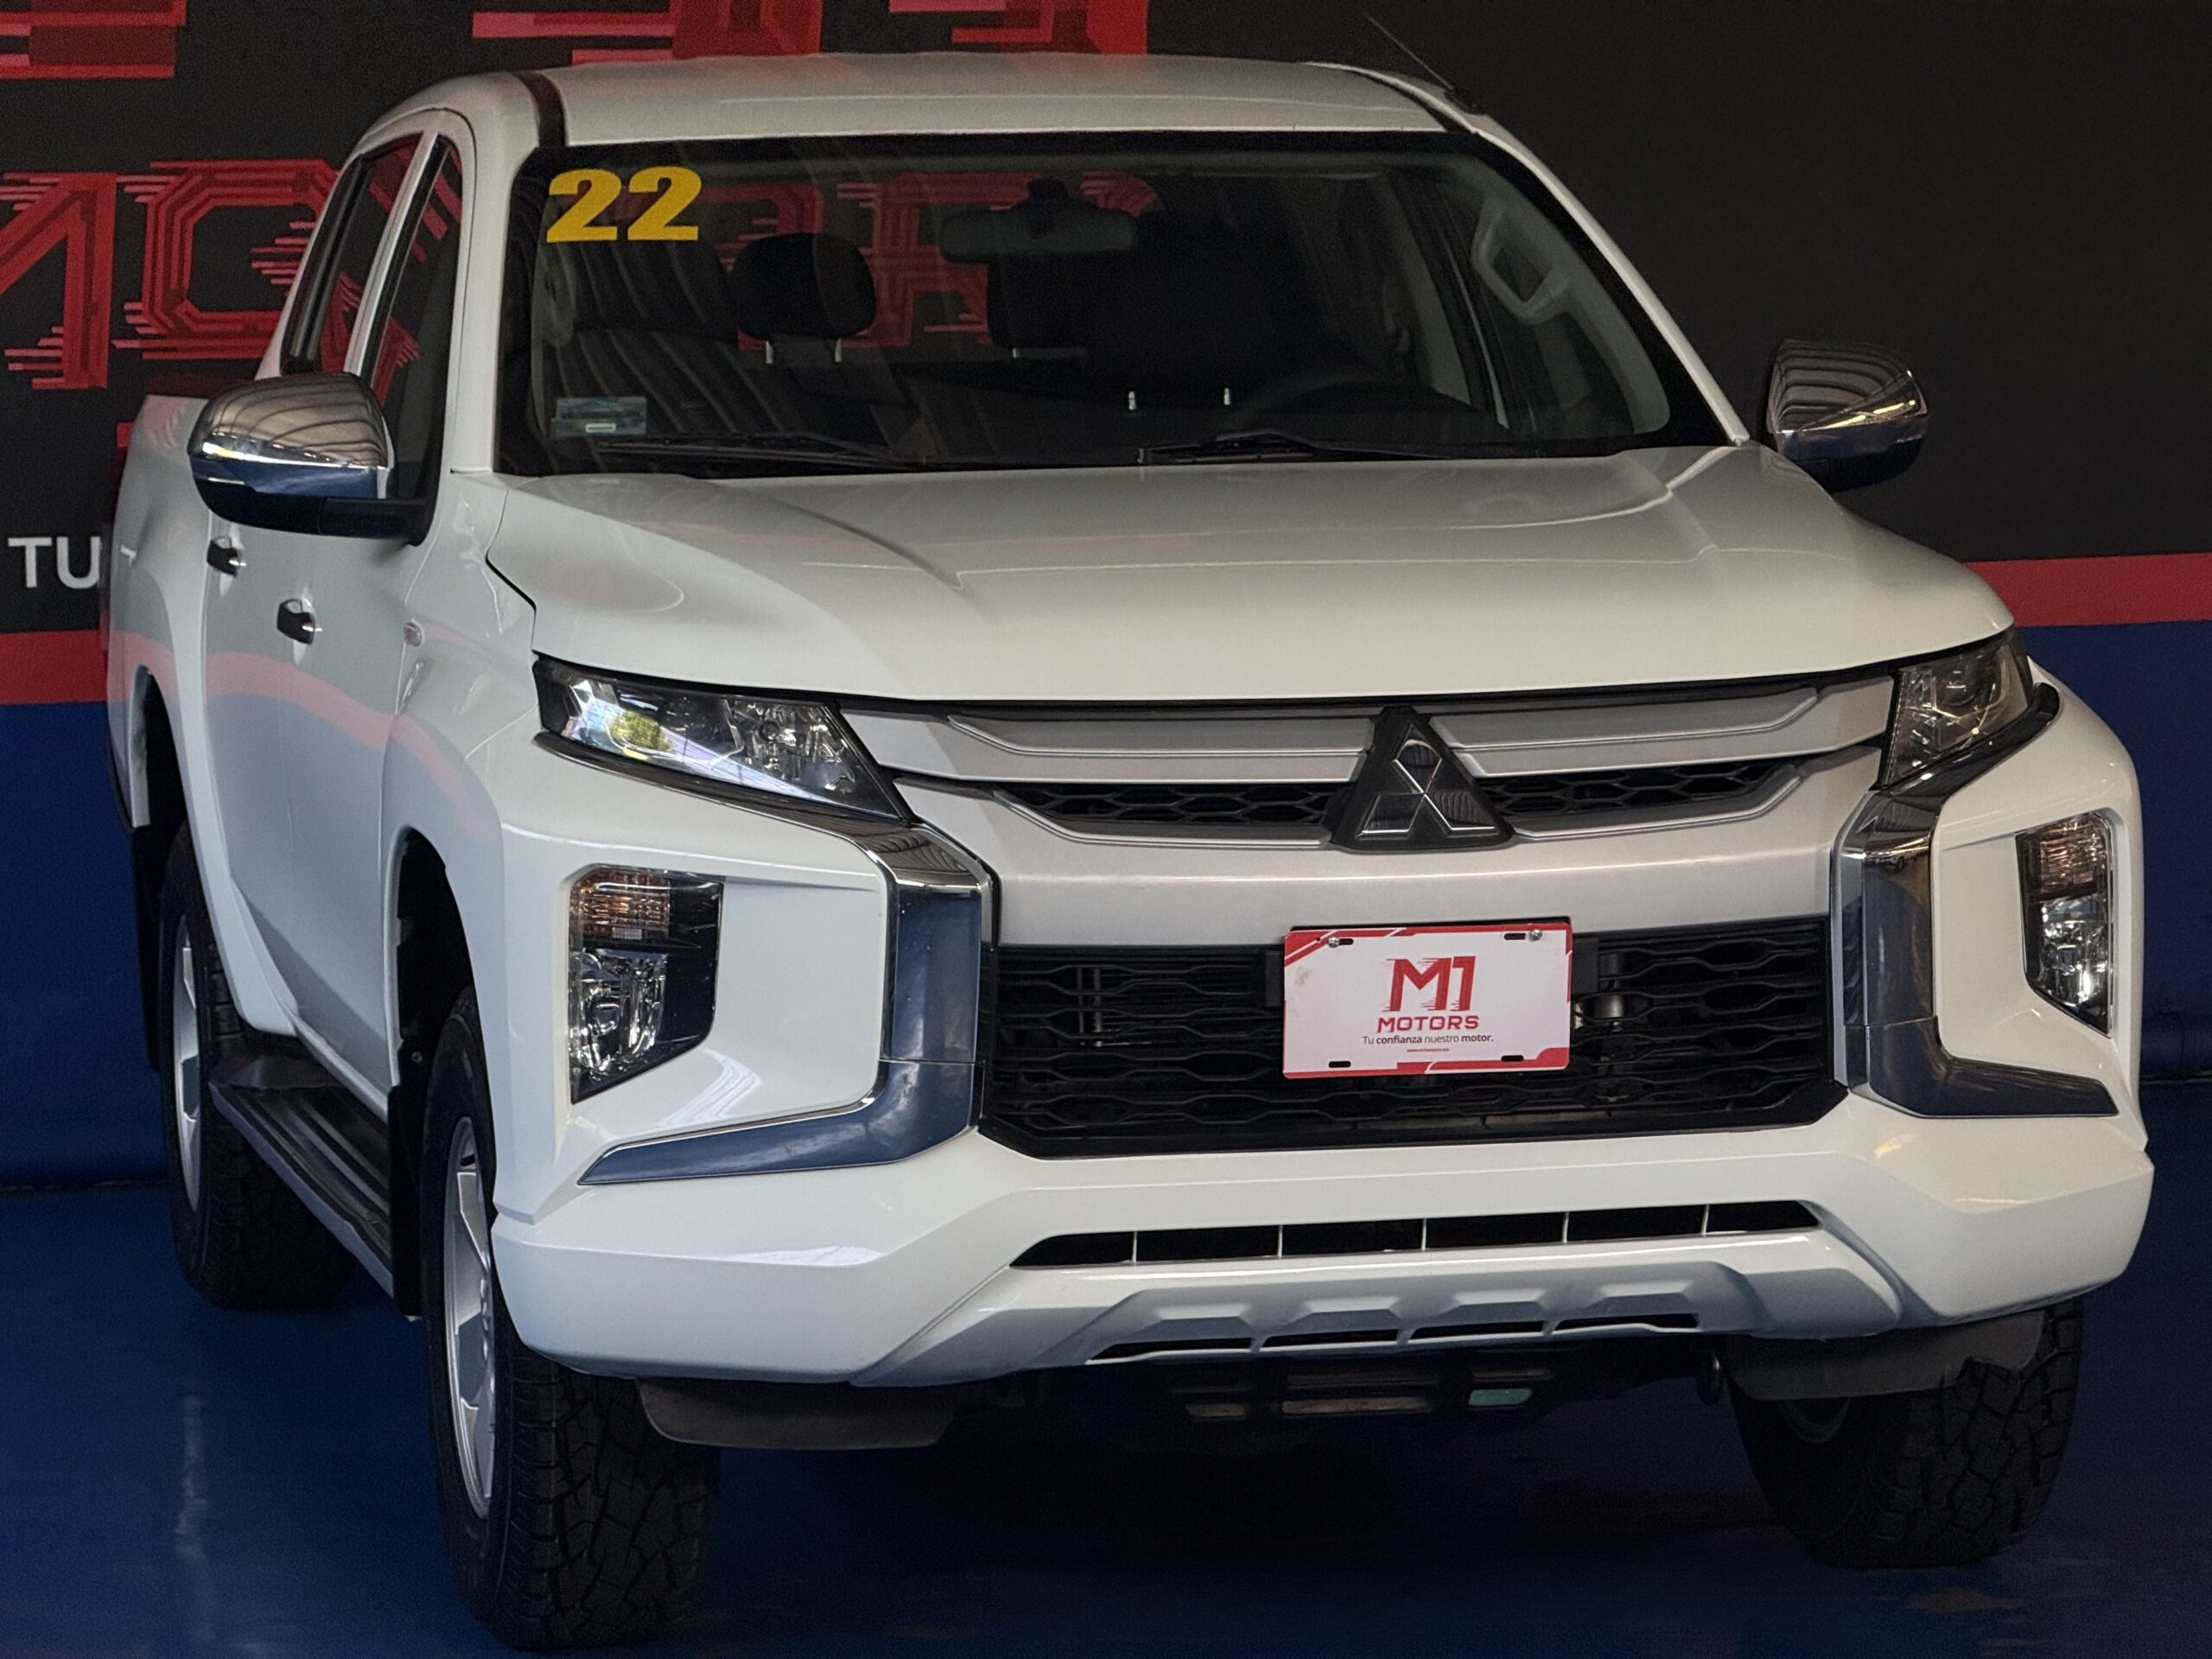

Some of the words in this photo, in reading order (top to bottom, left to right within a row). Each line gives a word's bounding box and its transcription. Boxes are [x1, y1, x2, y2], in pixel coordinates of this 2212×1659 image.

[546, 165, 702, 242] 22
[8, 536, 102, 589] TU
[1382, 956, 1476, 1012] M1
[1363, 1036, 1374, 1045] Tu
[1376, 1034, 1422, 1045] confianza
[1425, 1033, 1459, 1043] nuestro
[1461, 1033, 1494, 1042] motor.
[1377, 1015, 1479, 1033] MOTORS
